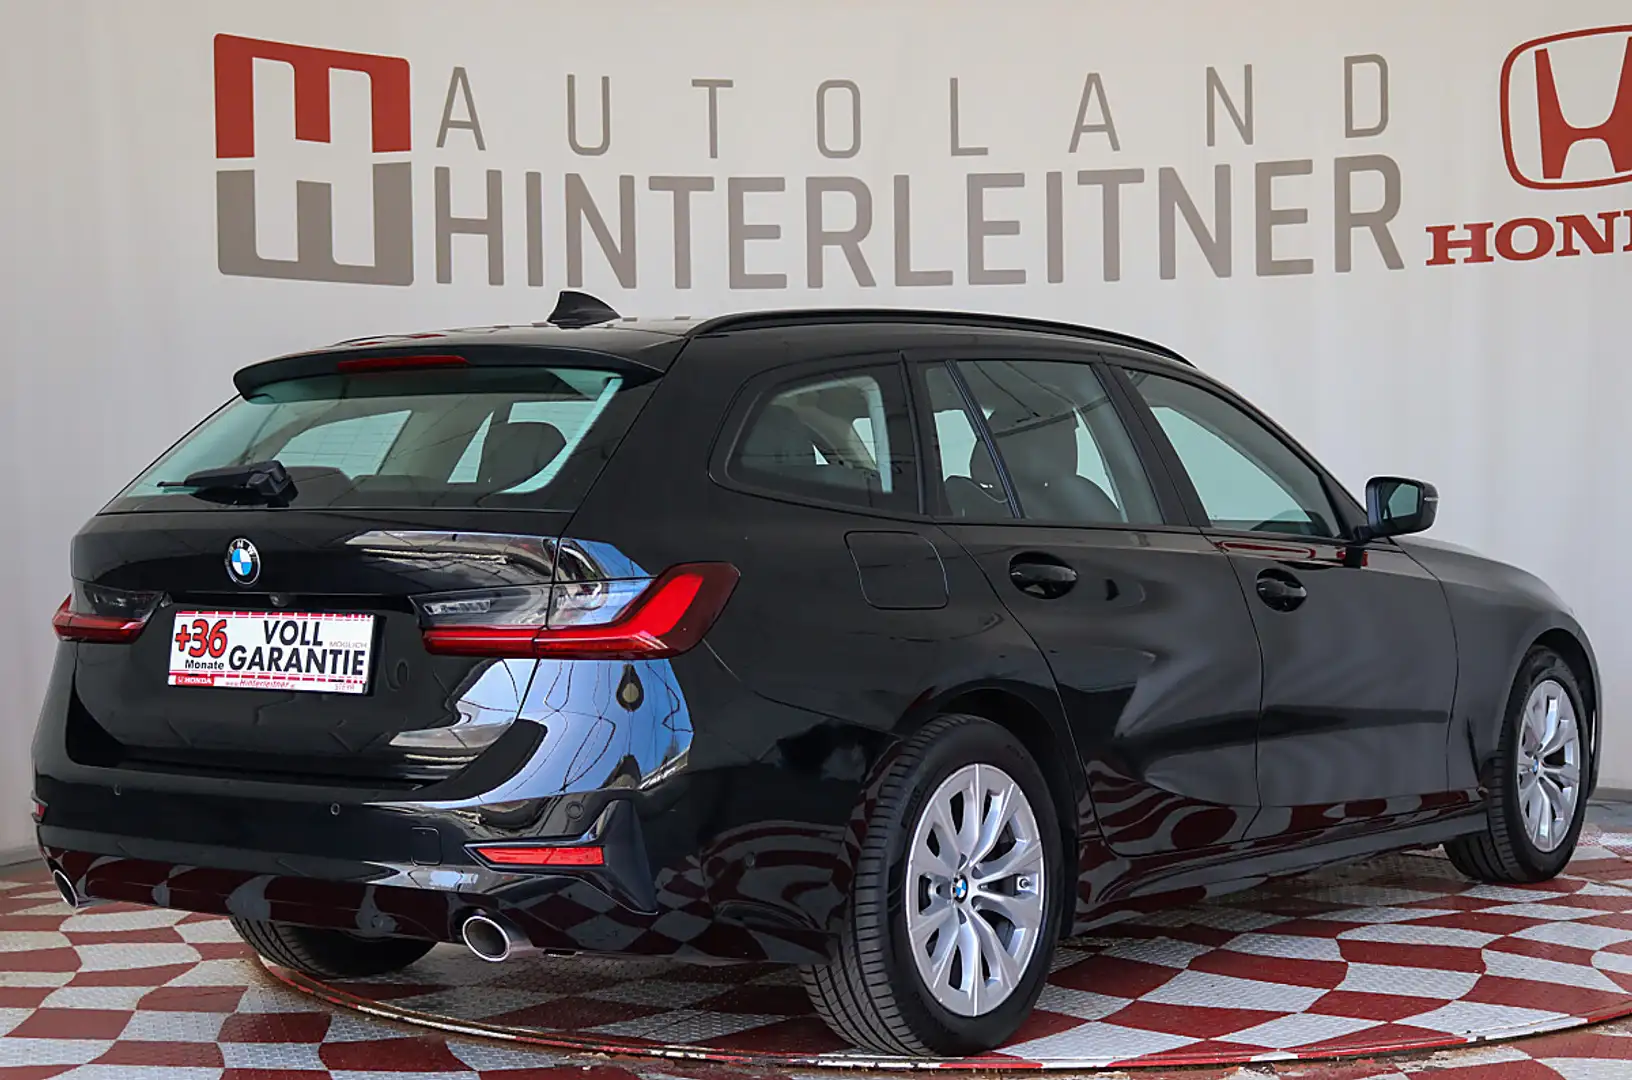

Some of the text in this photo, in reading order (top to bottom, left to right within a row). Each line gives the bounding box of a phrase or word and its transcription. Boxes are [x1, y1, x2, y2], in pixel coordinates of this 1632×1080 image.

[436, 53, 1389, 159] AUTOLAND
[434, 153, 1405, 289] HINTERLEITNER
[1425, 209, 1632, 266] HON
[174, 618, 228, 658] +36
[263, 620, 324, 647] VOLL
[185, 659, 225, 671] Monate
[228, 645, 366, 676] GARANTIE
[183, 676, 213, 684] HONDA
